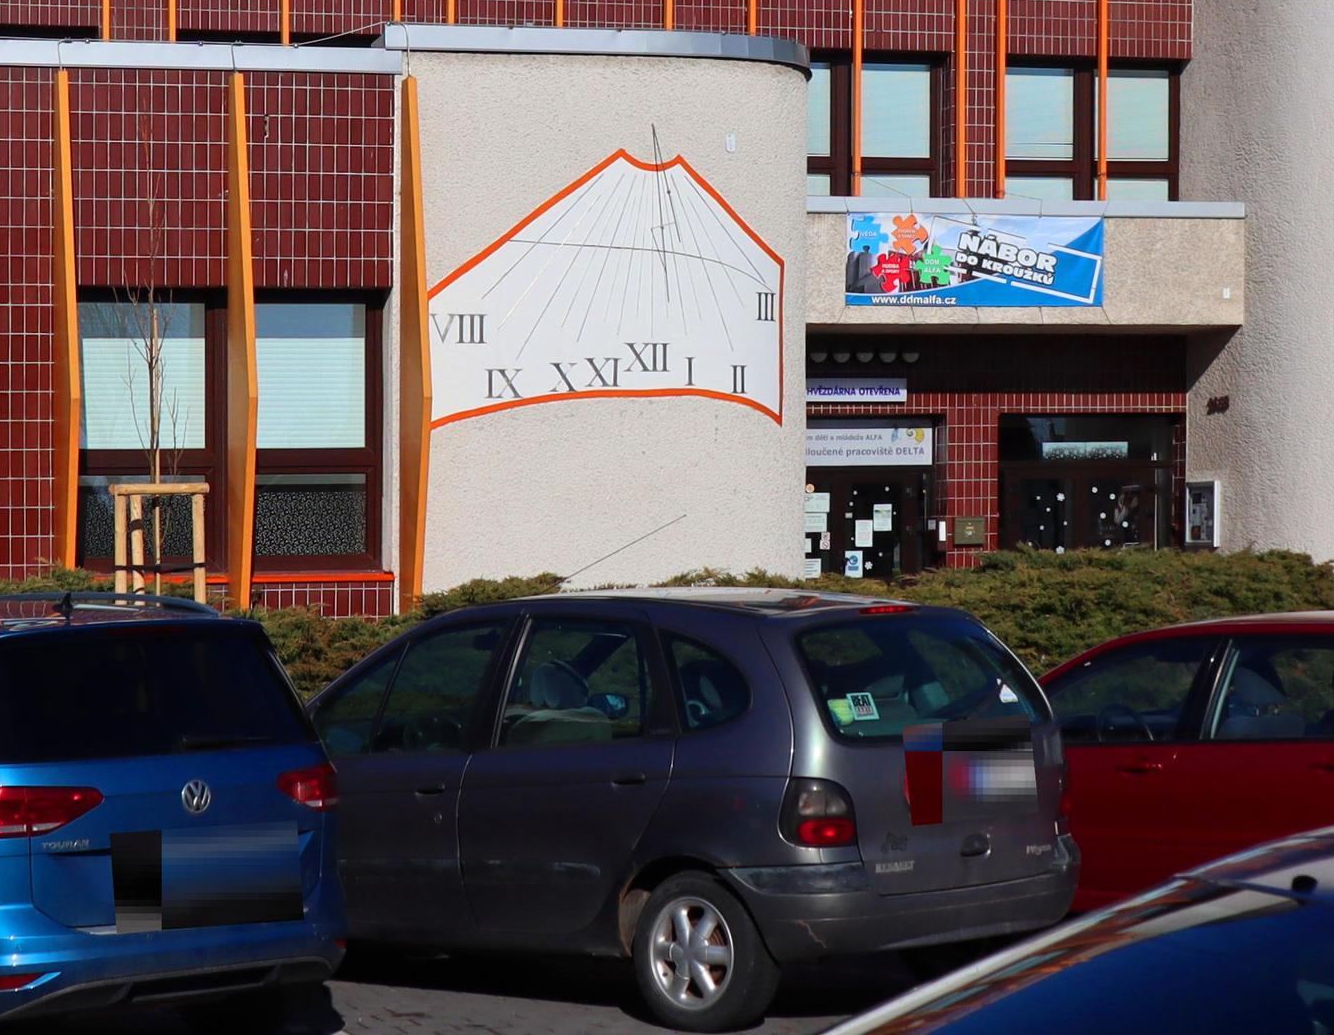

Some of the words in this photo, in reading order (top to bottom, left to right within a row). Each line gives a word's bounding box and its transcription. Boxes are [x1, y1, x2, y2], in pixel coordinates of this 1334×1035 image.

[955, 251, 979, 266] DO
[958, 232, 1057, 273] NÁBOR
[871, 295, 957, 305] www.ddmalfa.cz
[430, 313, 487, 345] VIII
[484, 368, 523, 399] IX
[550, 362, 578, 392] X
[584, 357, 622, 388] XI
[624, 342, 670, 373] XII
[684, 356, 696, 387] I
[730, 364, 748, 395] II
[755, 291, 776, 322] III
[806, 446, 843, 456] loučené
[895, 447, 925, 455] DELTA
